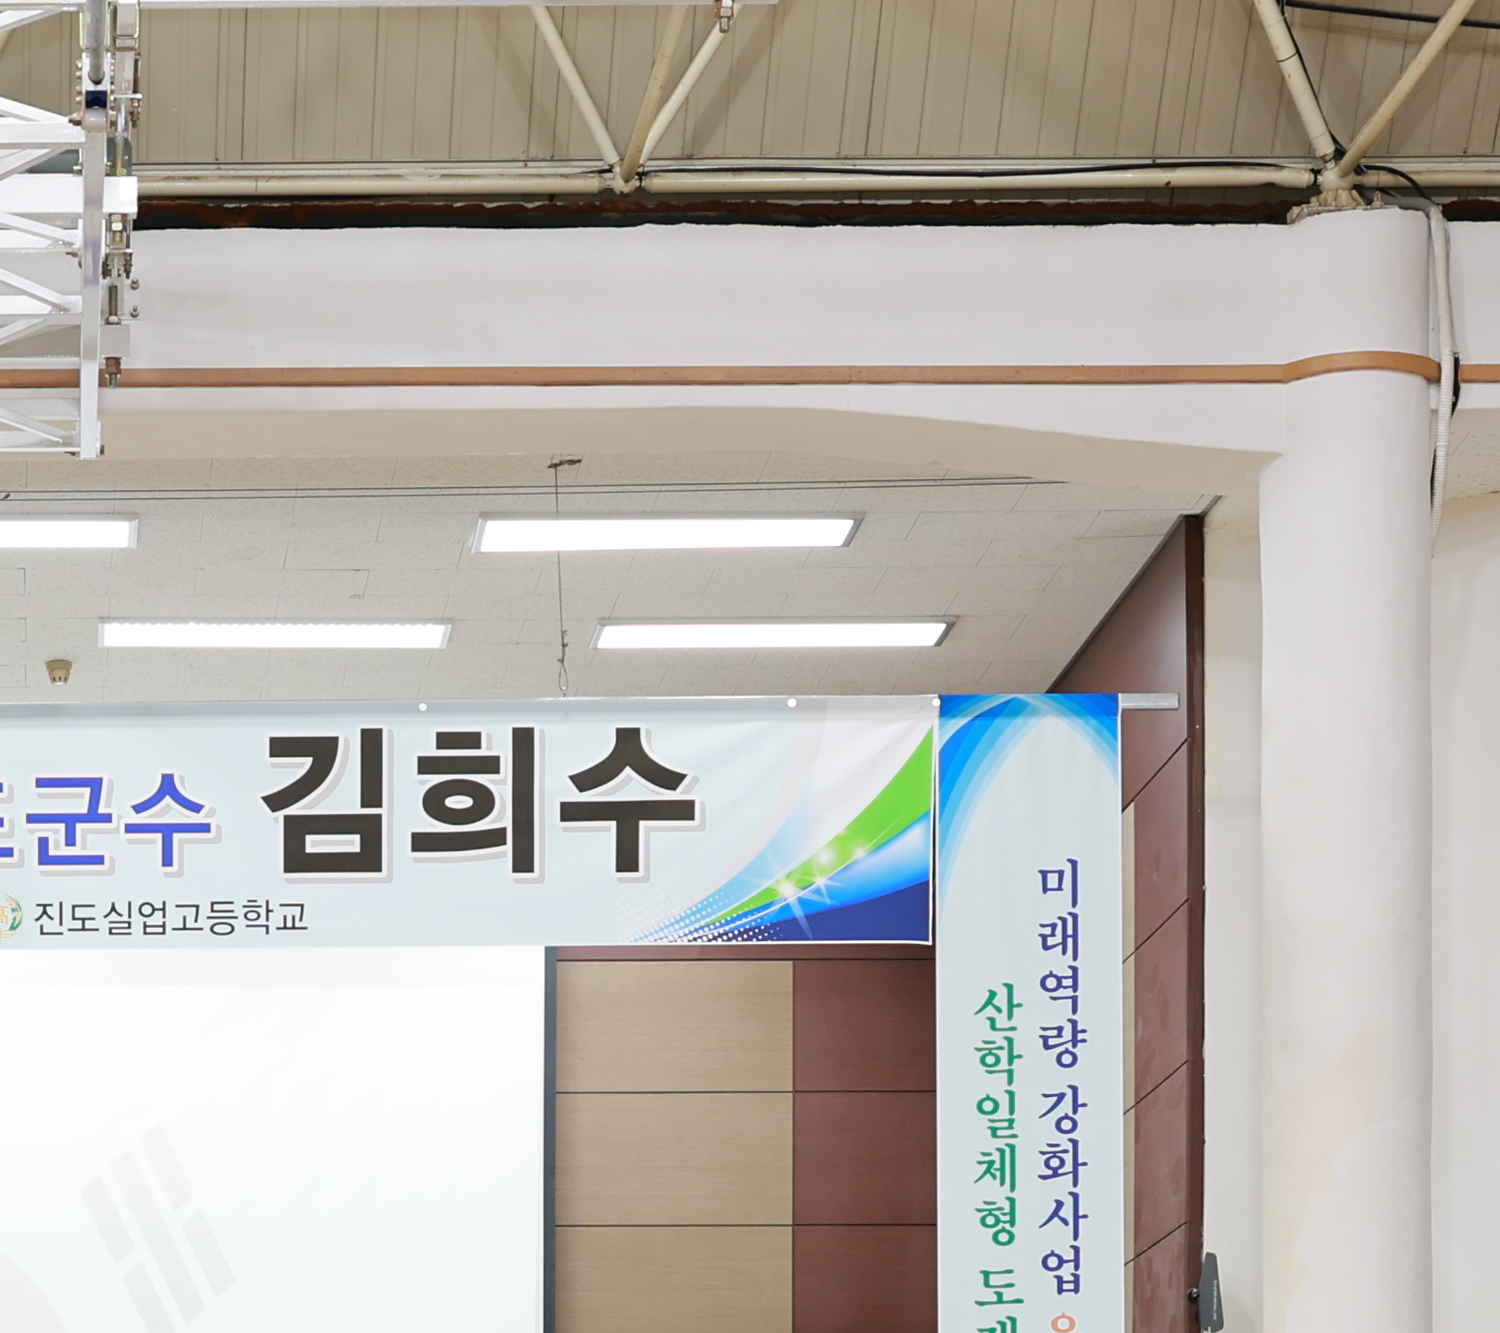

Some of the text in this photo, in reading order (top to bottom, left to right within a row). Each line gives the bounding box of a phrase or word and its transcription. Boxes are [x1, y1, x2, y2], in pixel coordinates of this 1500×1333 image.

[259, 726, 697, 875] 김희수
[33, 899, 309, 938] 진도실업고등학교
[1037, 857, 1088, 1069] 미래역량
[973, 981, 1024, 1247] 산학일체형
[1037, 1084, 1089, 1296] 강화사업
